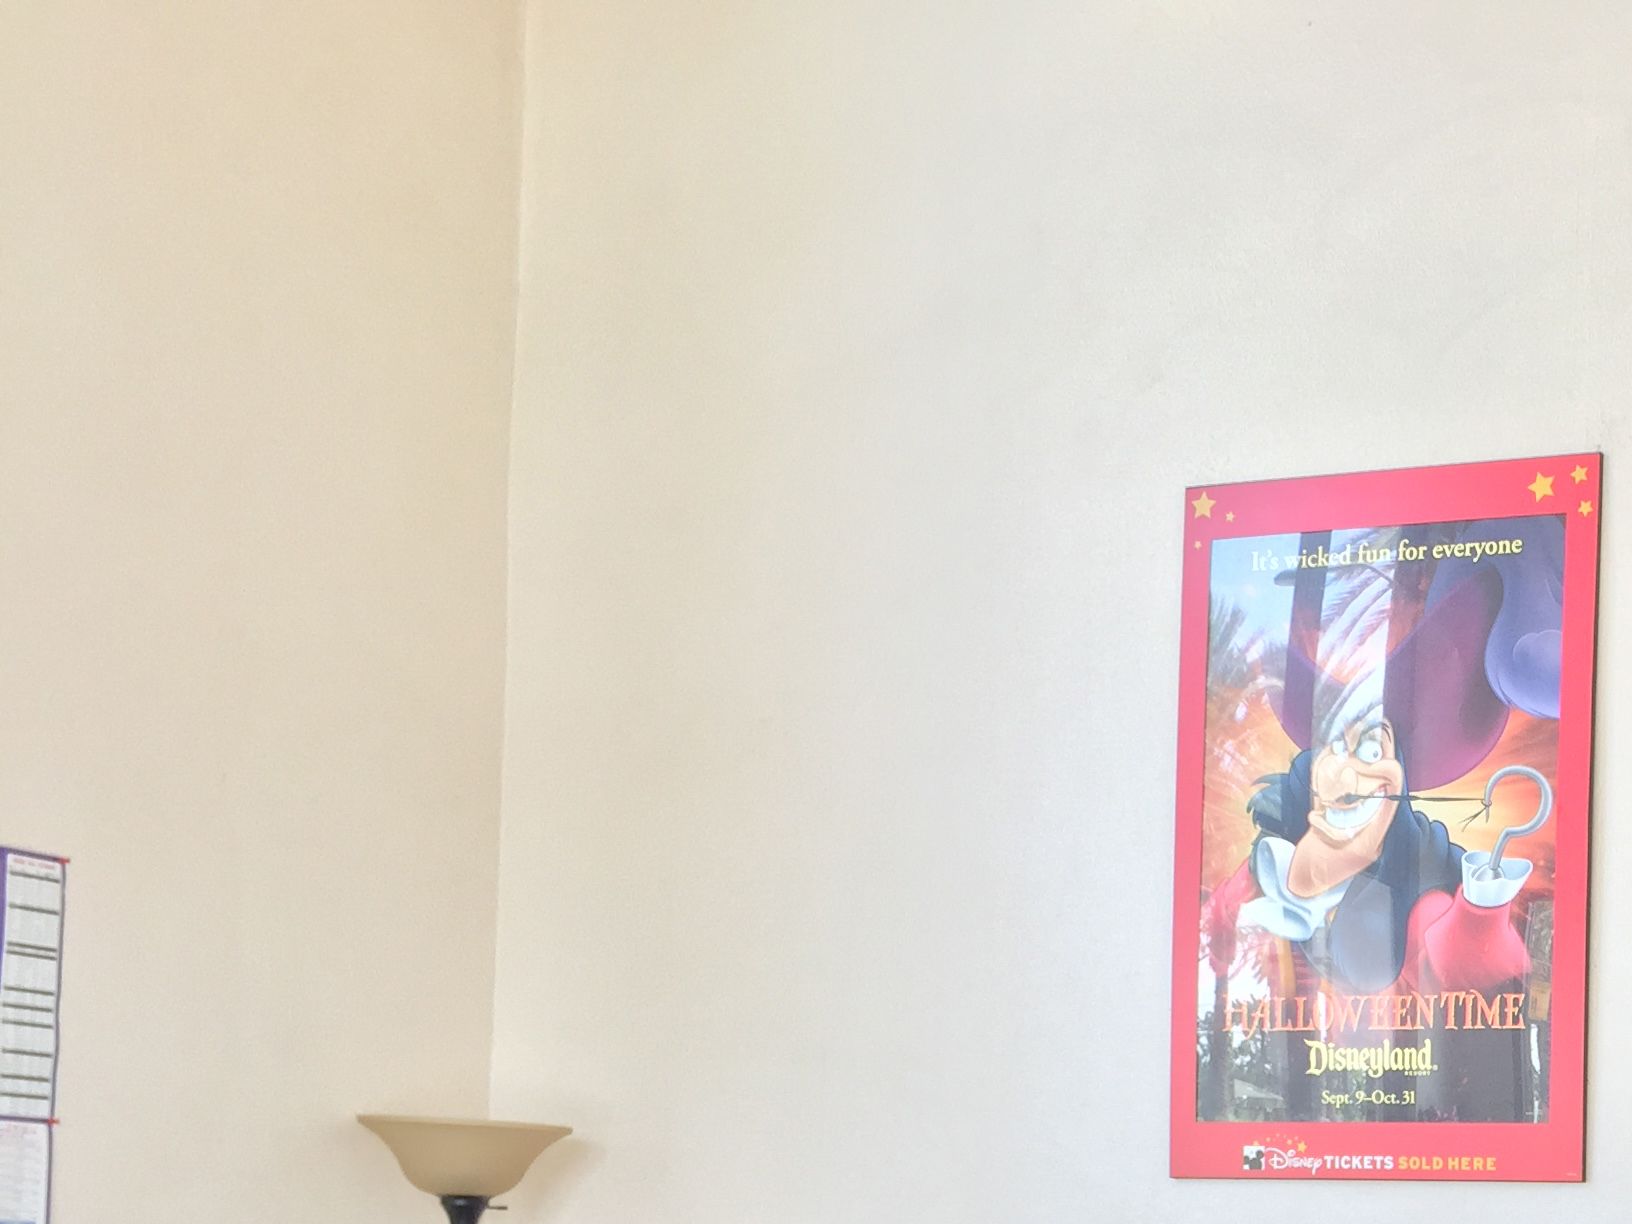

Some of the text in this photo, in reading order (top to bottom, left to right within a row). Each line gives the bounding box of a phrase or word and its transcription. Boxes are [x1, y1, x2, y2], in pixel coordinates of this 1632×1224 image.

[1251, 538, 1523, 571] It's wicked fun for everyone
[1304, 1038, 1433, 1078] Disneyland
[1321, 1090, 1353, 1108] Sept.
[1401, 1090, 1416, 1105] 31
[1264, 1147, 1497, 1175] Disney TICKETS SOLD HERE
